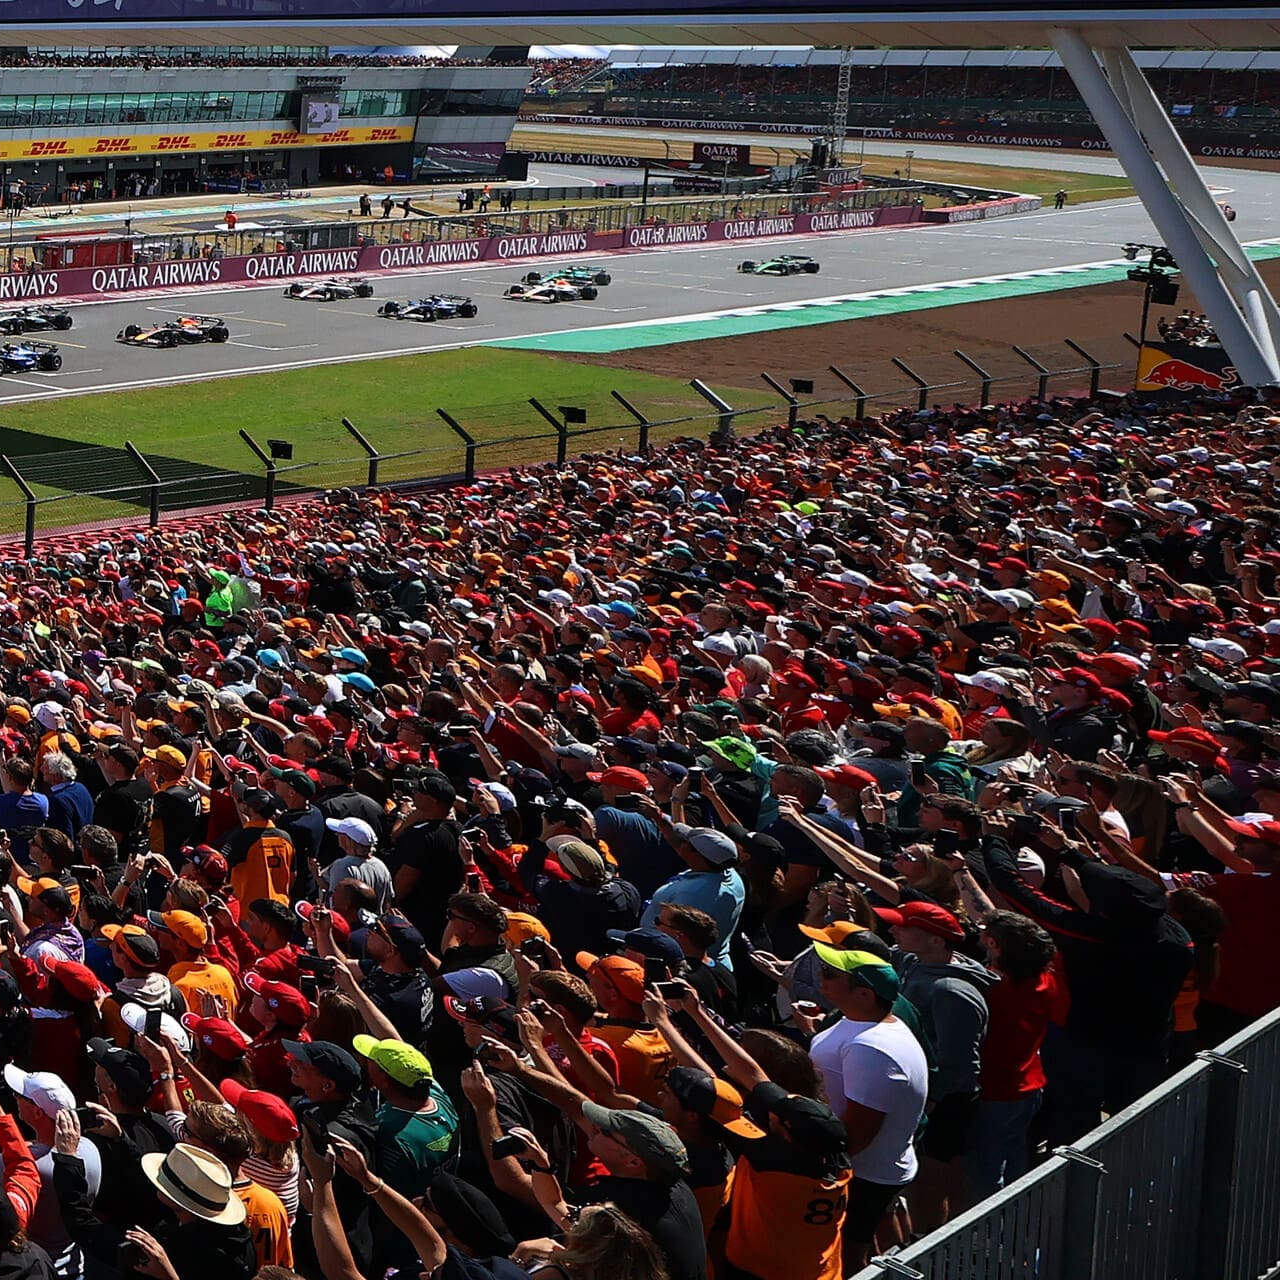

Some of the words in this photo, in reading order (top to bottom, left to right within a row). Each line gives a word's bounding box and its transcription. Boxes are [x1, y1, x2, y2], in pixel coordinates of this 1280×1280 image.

[568, 116, 602, 125] QATAR
[604, 117, 648, 127] AIRWAYS
[661, 119, 699, 129] QATAR
[701, 120, 745, 131] AIRWAYS
[371, 128, 399, 140] DHL
[759, 124, 797, 134] QATAR
[863, 128, 903, 139] QATAR
[905, 131, 955, 142] AIRWAYS
[30, 141, 69, 155] DHL
[94, 138, 132, 152] DHL
[158, 136, 191, 150] DHL
[215, 135, 247, 148] DHL
[966, 134, 1007, 145] QATAR
[1008, 136, 1063, 148] AIRWAYS
[1081, 139, 1112, 150] QATA
[702, 144, 738, 157] QATAR
[1201, 145, 1245, 157] QATAR
[575, 153, 640, 168] AIRWAYS
[725, 221, 755, 239] QATAR
[757, 218, 794, 235] AIRWAYS
[811, 214, 838, 231] QATAR
[841, 212, 874, 227] AIRWAYS
[631, 228, 662, 246] QATAR
[666, 225, 707, 242] AIRWAYS
[499, 237, 537, 258] QATAR
[540, 234, 586, 252] AIRWAYS
[381, 247, 423, 268] QATAR
[427, 242, 479, 263] AIRWAYS
[246, 256, 294, 279] QATAR
[298, 251, 357, 273] AIRWAYS
[93, 267, 148, 292] QATAR
[153, 261, 220, 285] AIRWAYS
